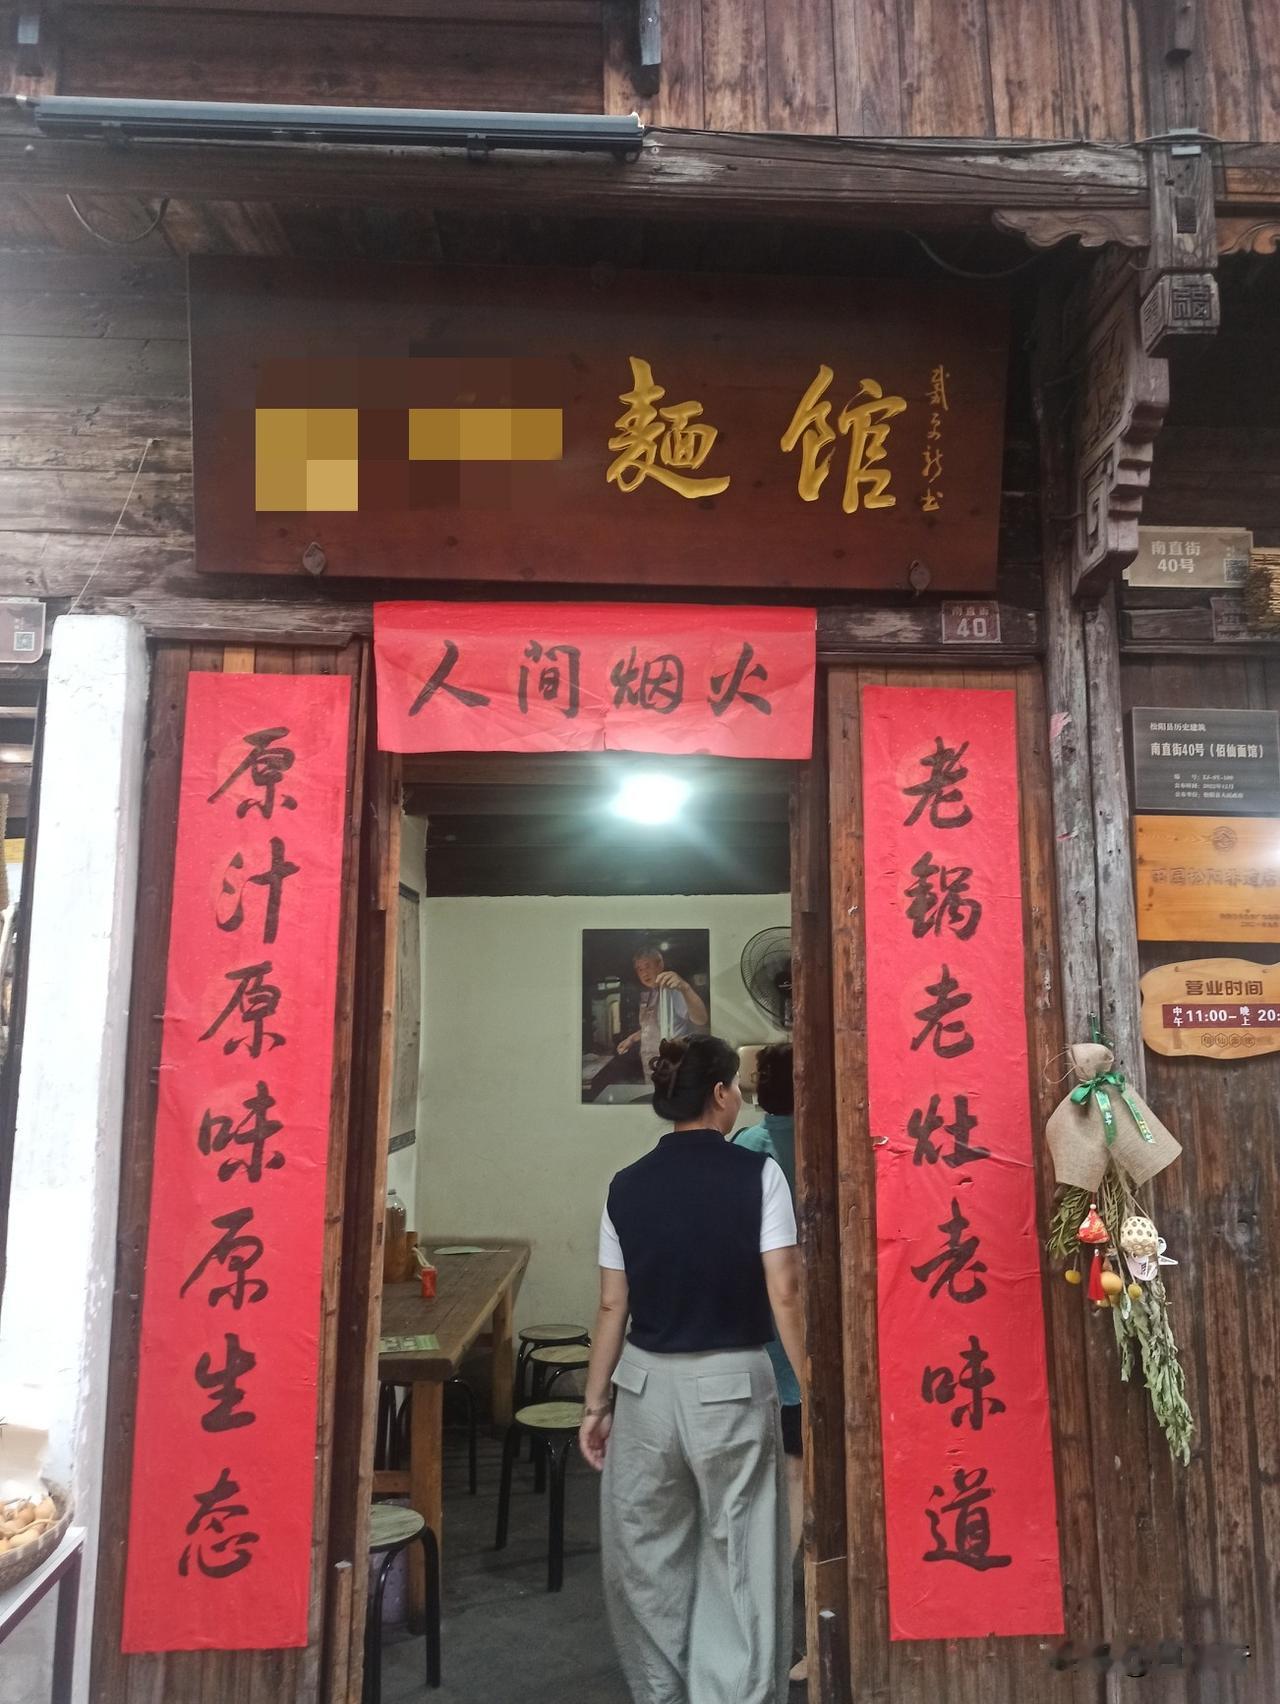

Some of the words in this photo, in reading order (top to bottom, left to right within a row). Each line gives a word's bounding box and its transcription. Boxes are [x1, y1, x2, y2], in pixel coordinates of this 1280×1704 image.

[1151, 541, 1201, 556] 南直街
[1157, 558, 1196, 574] 40号
[956, 617, 988, 638] 40
[1185, 980, 1263, 996] 营业时间
[1173, 1006, 1183, 1027] 中午
[1240, 1006, 1251, 1026] 晚上
[178, 726, 300, 1580] 原汁原味原生态
